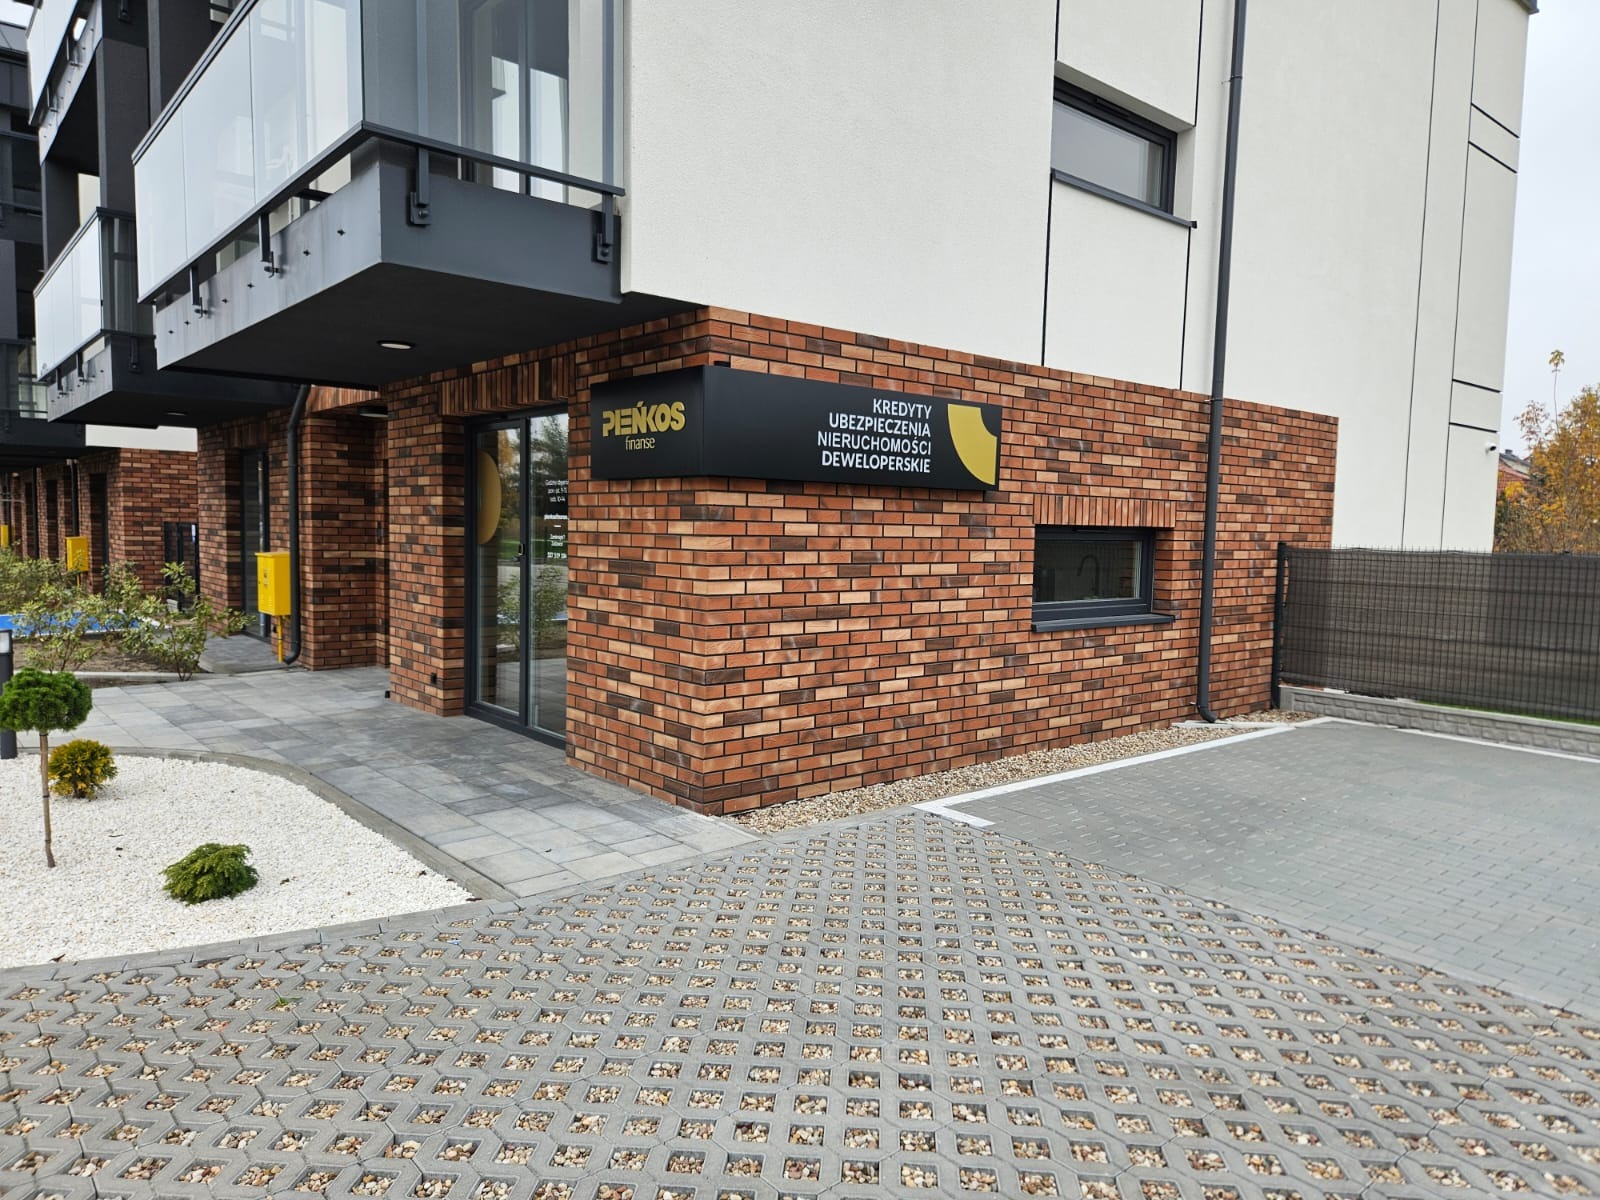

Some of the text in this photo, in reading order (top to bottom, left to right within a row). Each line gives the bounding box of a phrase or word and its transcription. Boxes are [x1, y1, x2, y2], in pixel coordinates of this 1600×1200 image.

[602, 400, 685, 437] PIEŃKOS
[873, 398, 932, 419] KREDYTY
[829, 412, 931, 437] UBEZPIECZENIA
[625, 435, 655, 450] finanse
[817, 430, 931, 455] NIERUCHOMOŚCI
[821, 450, 931, 473] DEWELOPERSKIE
